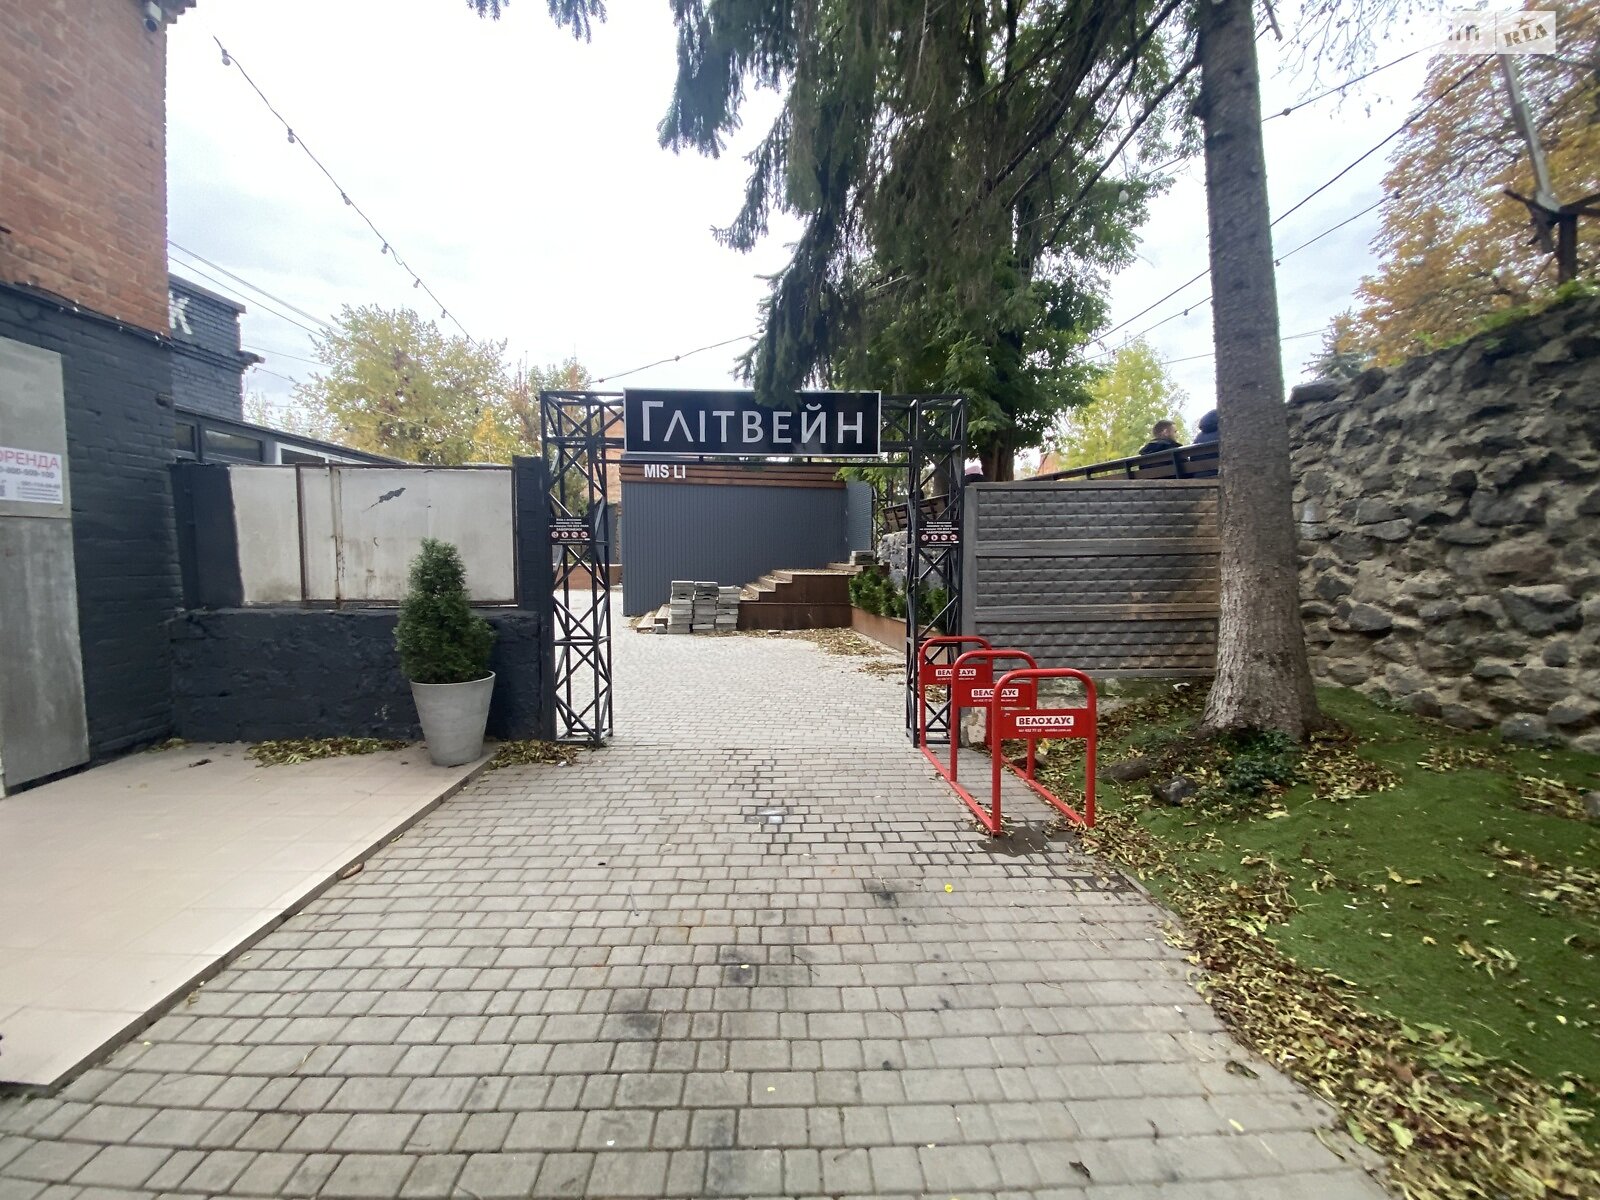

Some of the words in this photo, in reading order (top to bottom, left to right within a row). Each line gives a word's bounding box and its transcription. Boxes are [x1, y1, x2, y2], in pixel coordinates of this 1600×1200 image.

[642, 400, 863, 444] ГЛІТВЕЙН
[644, 464, 670, 479] MIS
[674, 464, 686, 479] LI
[973, 689, 1018, 697] ВЕЛОАУС
[1018, 717, 1071, 725] ВЕЛОХАУС
